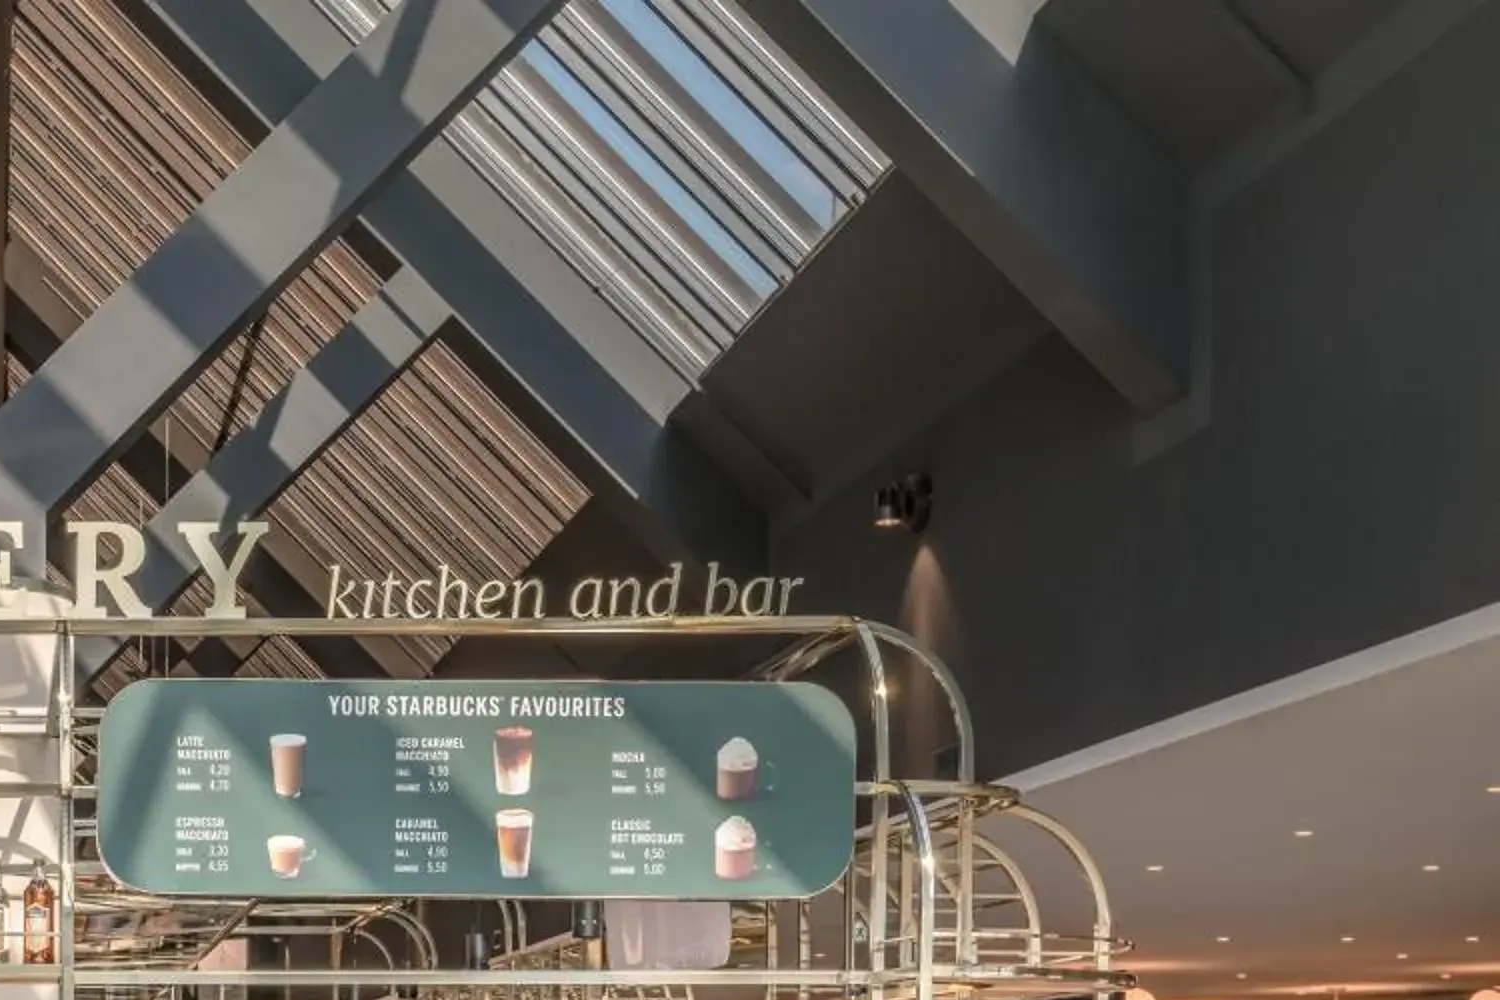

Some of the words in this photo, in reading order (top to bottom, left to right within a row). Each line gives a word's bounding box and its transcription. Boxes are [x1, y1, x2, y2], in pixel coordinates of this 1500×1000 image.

[326, 564, 547, 619] kitchen
[570, 562, 682, 618] and
[704, 561, 804, 617] bar
[328, 694, 380, 717] YOUR
[510, 696, 626, 718] FAVOURITES
[177, 735, 205, 747] LATTE
[395, 737, 419, 749] ICED
[421, 736, 466, 749] CARAMEL
[177, 749, 231, 761] MACCHIATO
[395, 750, 450, 762] MACCHIATO
[611, 751, 646, 763] MOCHA
[175, 816, 225, 829] ESPRESSO
[395, 818, 438, 830] CARAMEL
[611, 819, 651, 831] CLASSIC
[175, 830, 229, 841] MACCHIATO
[395, 831, 449, 843] MACCHIATO
[631, 832, 685, 845] CHOCOLATE
